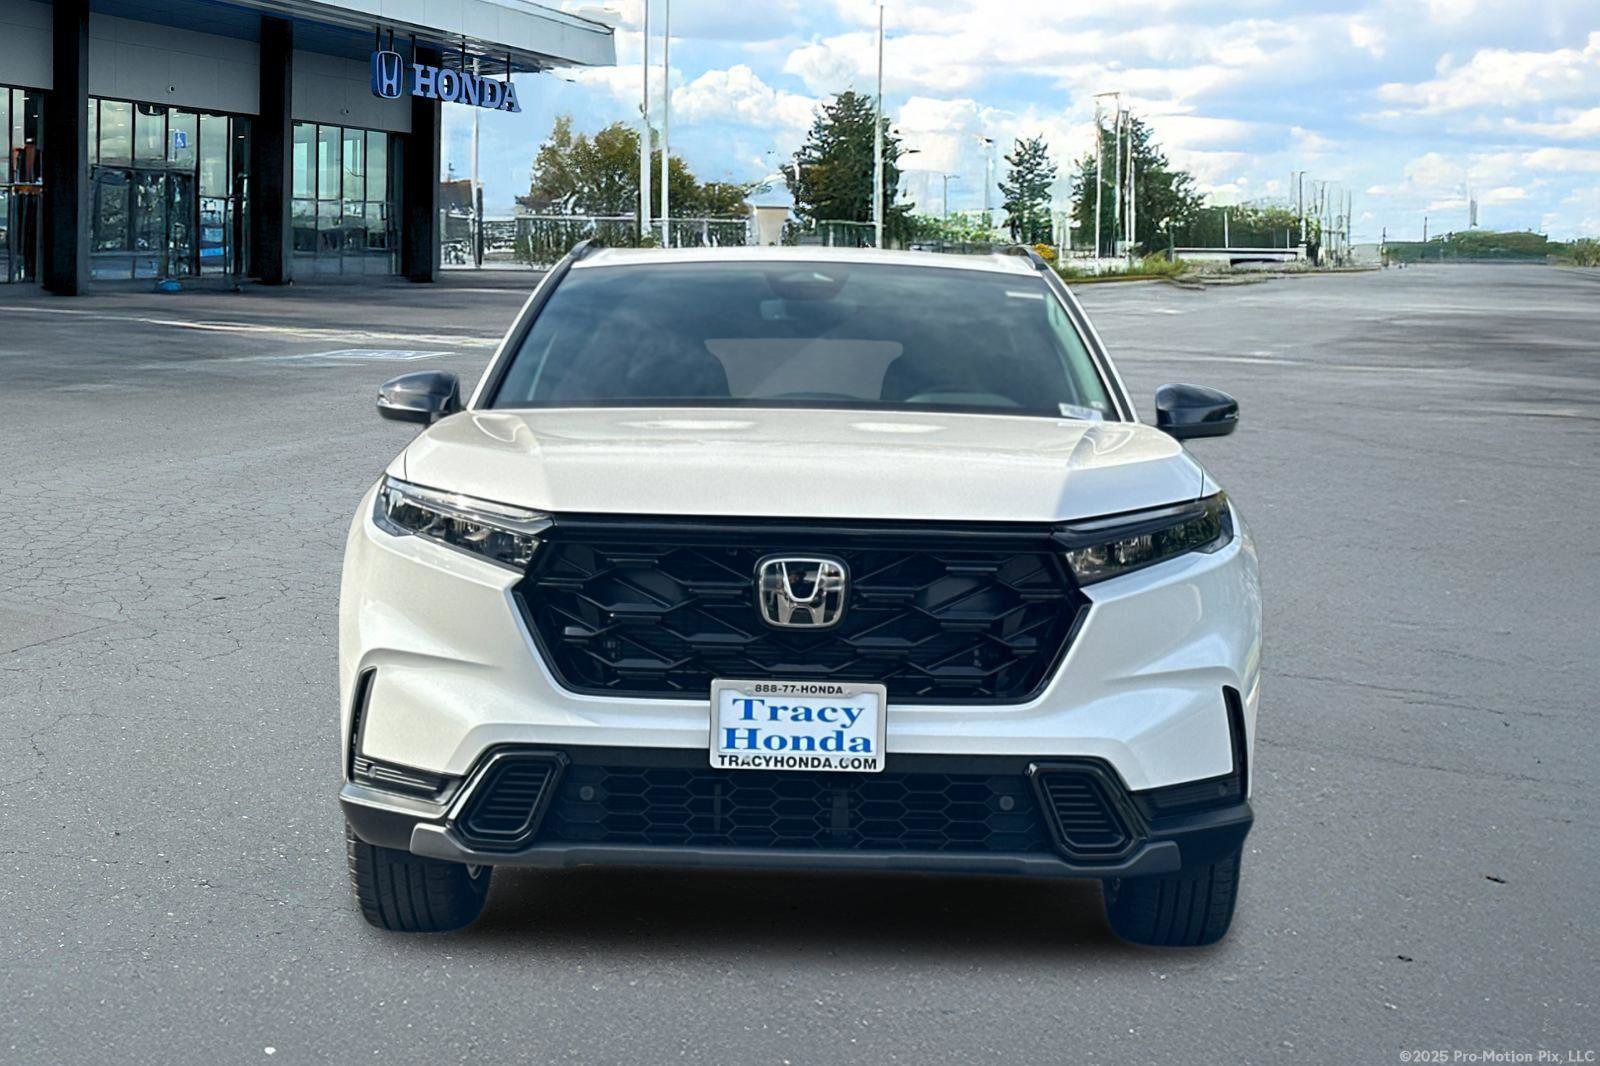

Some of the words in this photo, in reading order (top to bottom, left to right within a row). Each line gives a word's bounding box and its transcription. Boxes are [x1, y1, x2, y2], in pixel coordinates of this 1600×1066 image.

[411, 63, 522, 113] HONDA
[755, 684, 843, 694] 888-77-HONDA
[732, 698, 865, 729] Tracy
[722, 727, 873, 753] Honda
[718, 754, 877, 770] TRACYHONDA.COM
